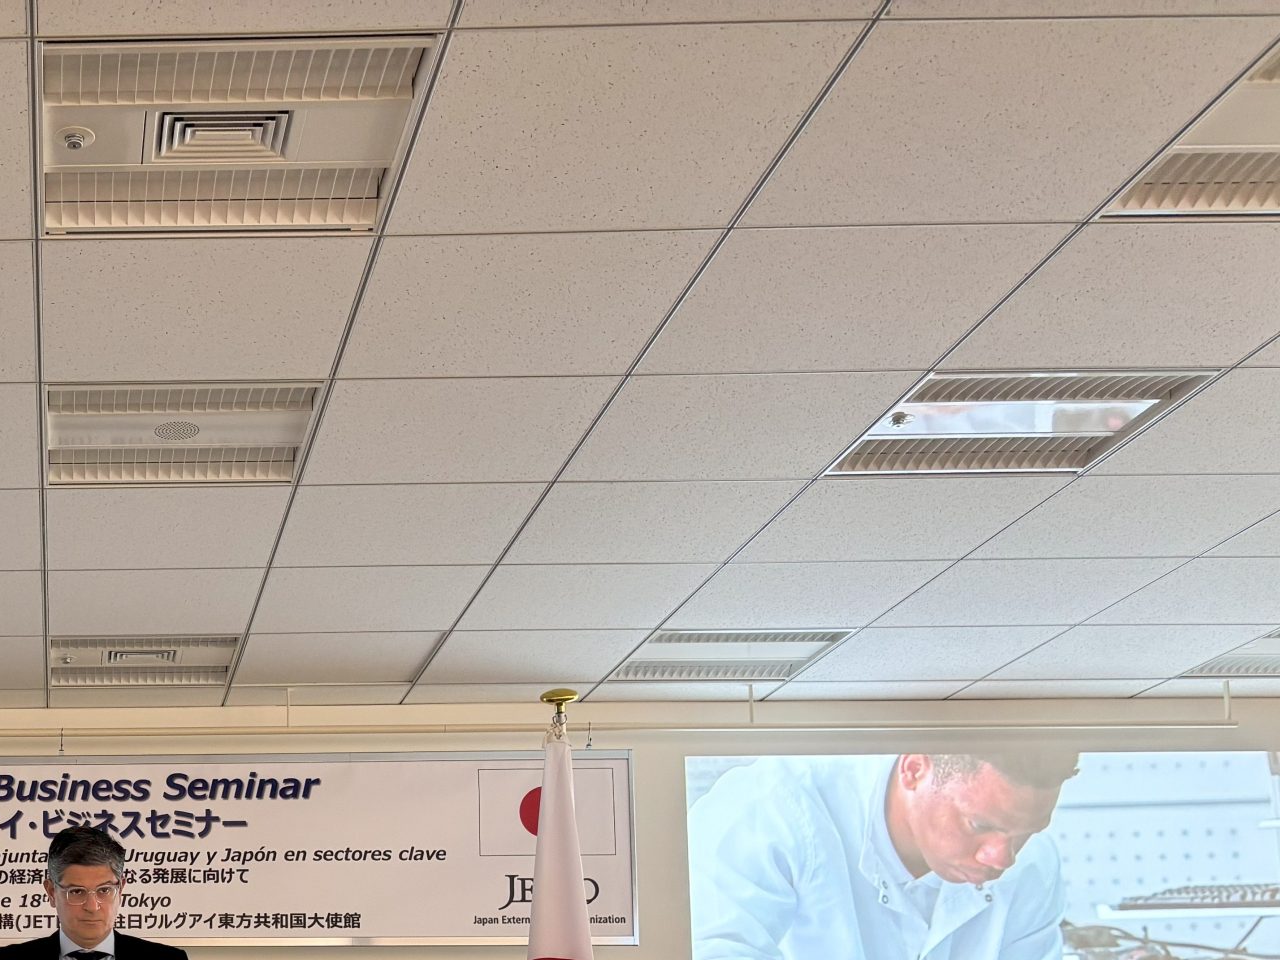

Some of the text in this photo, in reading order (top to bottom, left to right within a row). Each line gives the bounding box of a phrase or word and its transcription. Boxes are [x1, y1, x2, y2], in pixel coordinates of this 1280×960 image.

[163, 772, 321, 803] Seminar
[123, 848, 200, 865] Uruguay
[206, 851, 217, 865] y
[220, 847, 277, 865] Japón
[283, 850, 308, 862] en
[312, 848, 393, 863] sectores
[398, 846, 447, 862] clave
[19, 893, 50, 908] 18t
[120, 893, 172, 911] Tokyo
[473, 915, 499, 926] Japan
[501, 915, 531, 925] Extern
